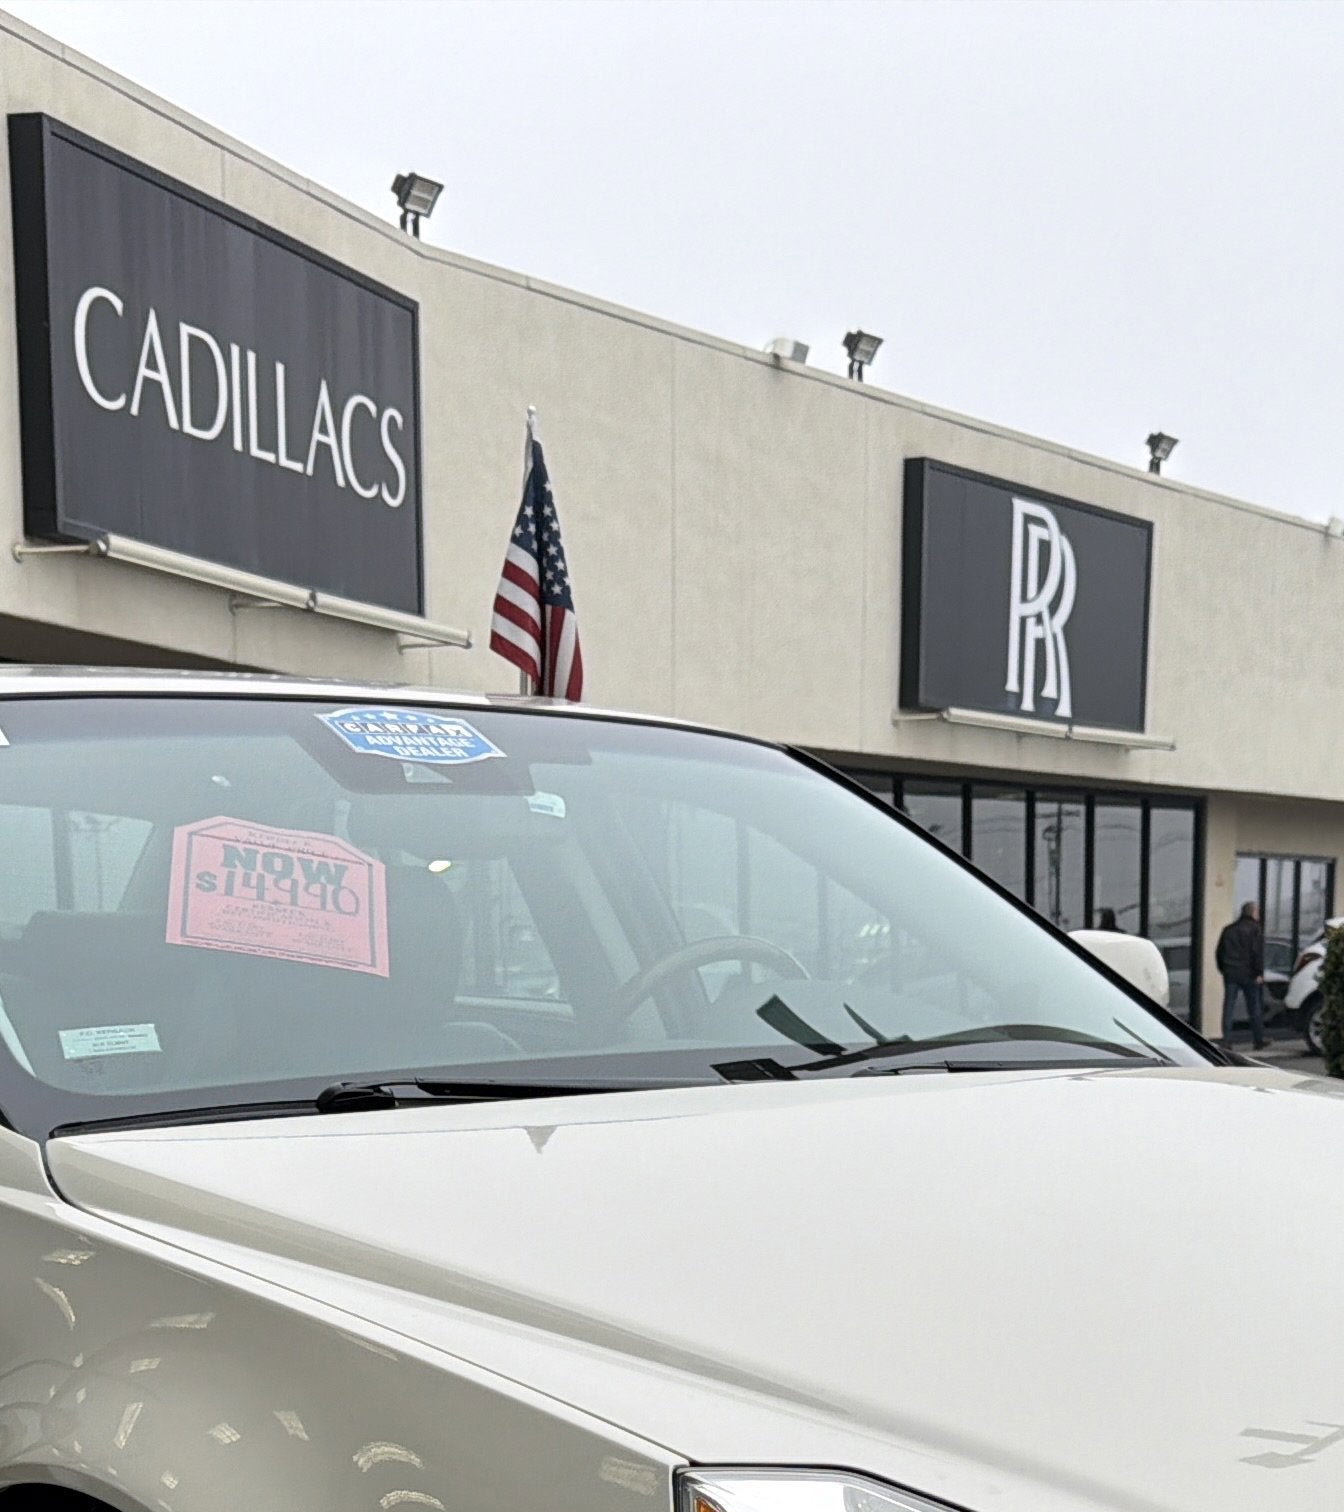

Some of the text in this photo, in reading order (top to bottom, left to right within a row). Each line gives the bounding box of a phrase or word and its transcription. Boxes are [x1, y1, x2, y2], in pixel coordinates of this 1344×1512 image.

[73, 285, 408, 509] CADILLACS
[364, 734, 477, 749] ADVANTAGE
[392, 745, 470, 758] DEALER
[220, 842, 349, 887] NOW
